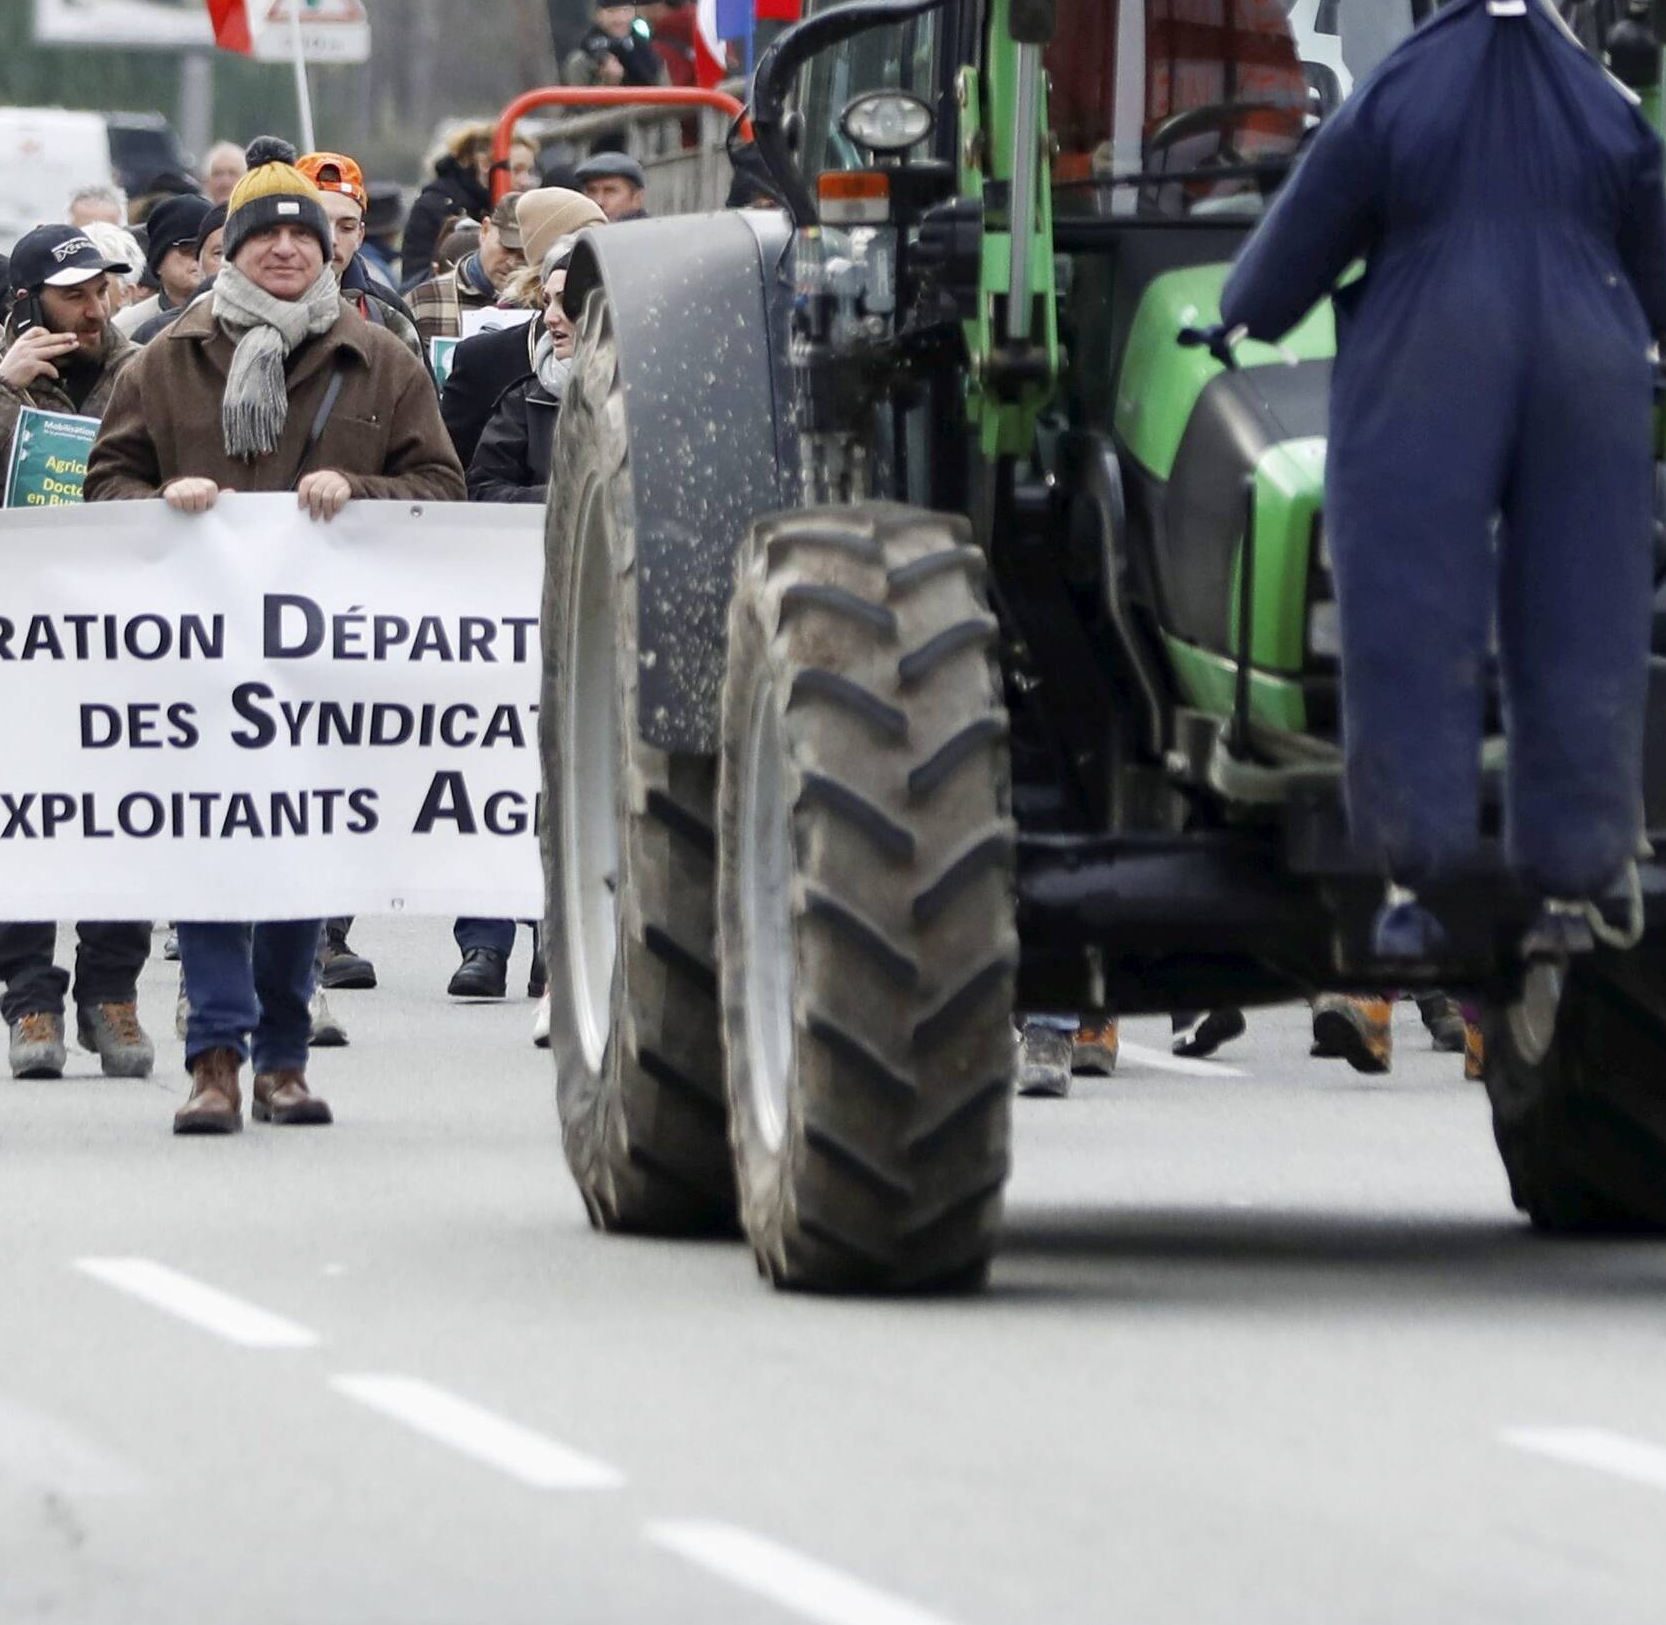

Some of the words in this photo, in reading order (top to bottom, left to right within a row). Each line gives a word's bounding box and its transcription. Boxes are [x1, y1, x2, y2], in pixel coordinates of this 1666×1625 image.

[27, 493, 45, 505] en
[42, 477, 84, 498] Docto
[262, 592, 540, 665] DÉPART
[79, 701, 200, 751] DES
